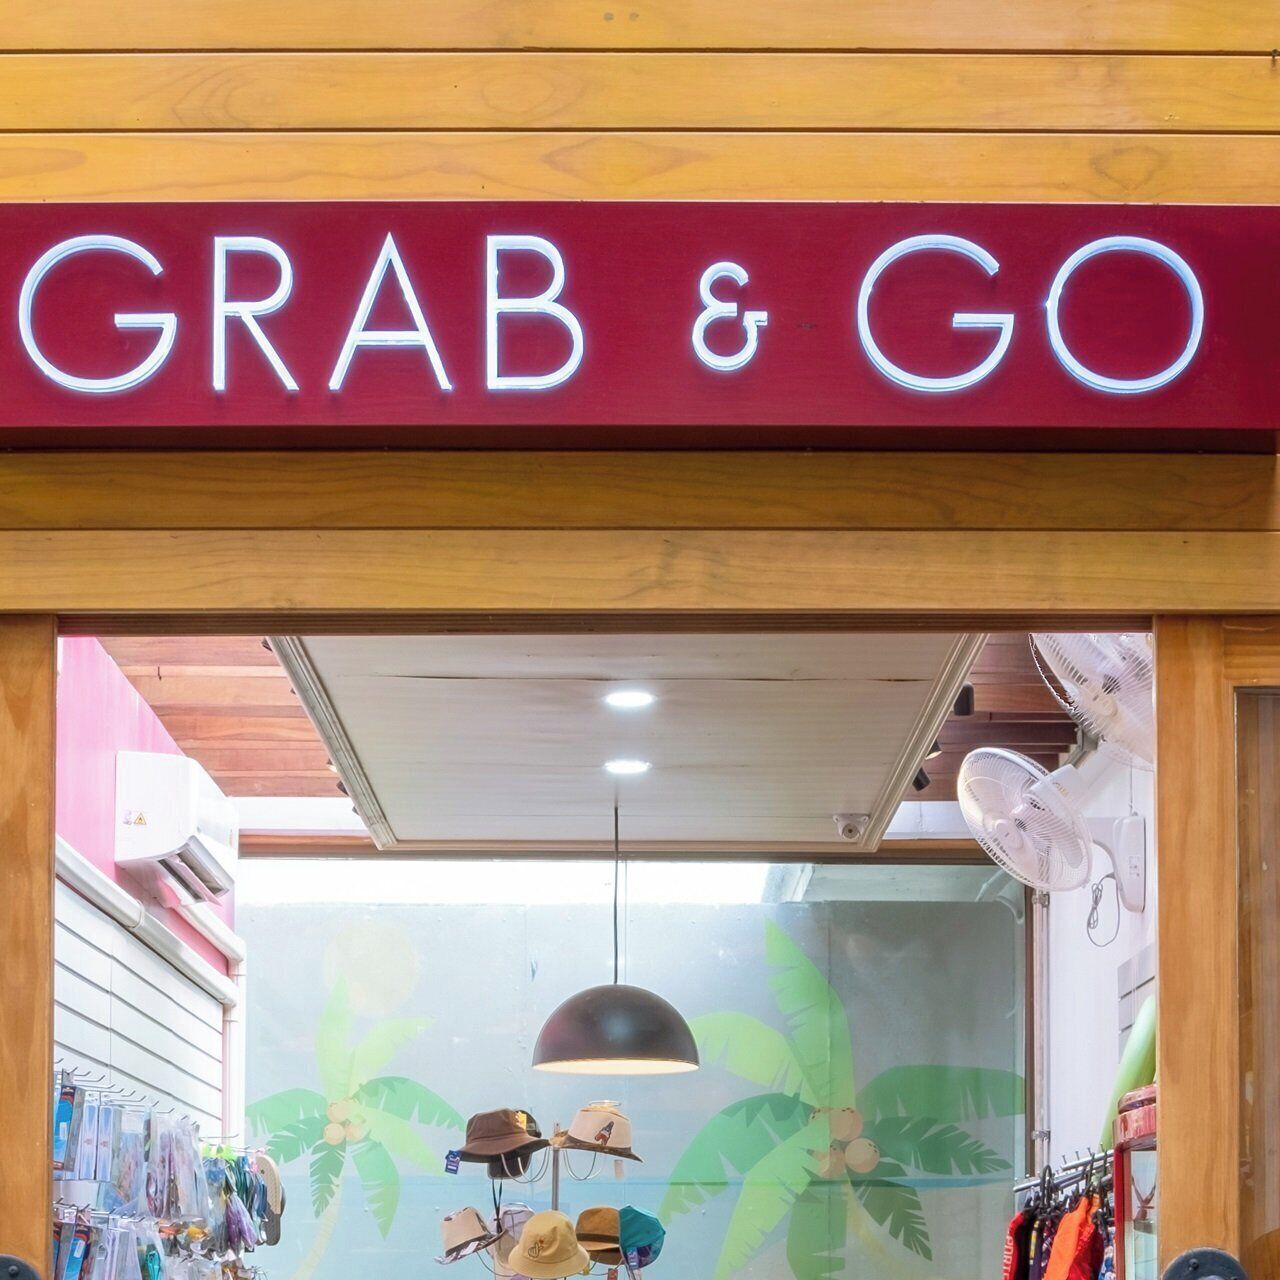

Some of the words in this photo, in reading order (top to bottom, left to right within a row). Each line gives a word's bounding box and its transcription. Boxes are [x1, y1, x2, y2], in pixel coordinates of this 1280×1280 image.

[18, 231, 585, 394] GRAB
[692, 261, 769, 371] &
[857, 232, 1204, 394] GO
